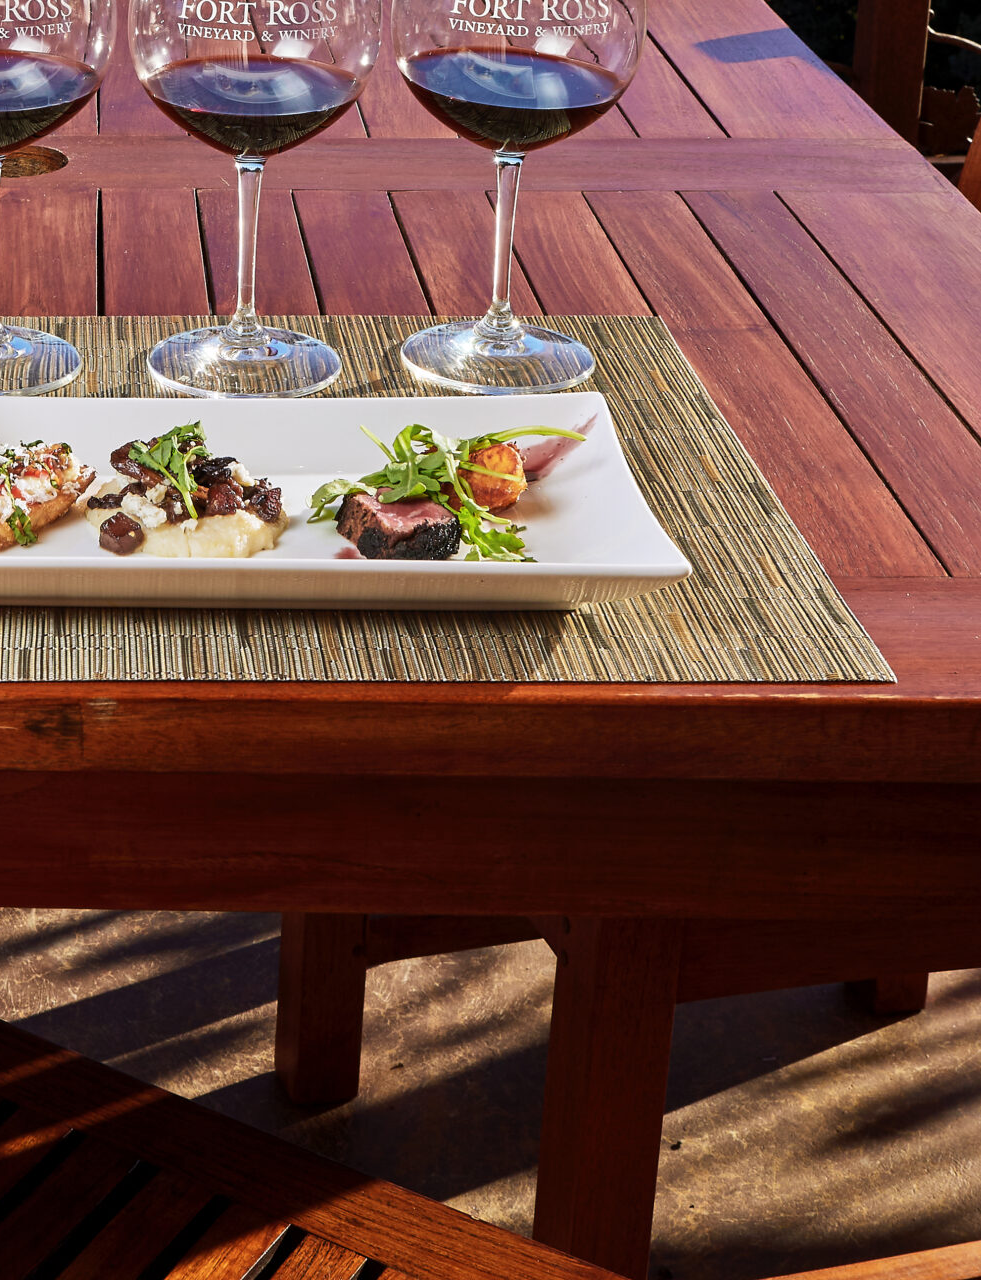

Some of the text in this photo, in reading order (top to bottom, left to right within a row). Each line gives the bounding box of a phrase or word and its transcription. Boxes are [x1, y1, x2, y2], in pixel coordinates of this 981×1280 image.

[14, 21, 73, 37] WINERY
[177, 22, 338, 42] VINEYARD & WINERY
[449, 18, 610, 37] VINEYARD & WINERY
